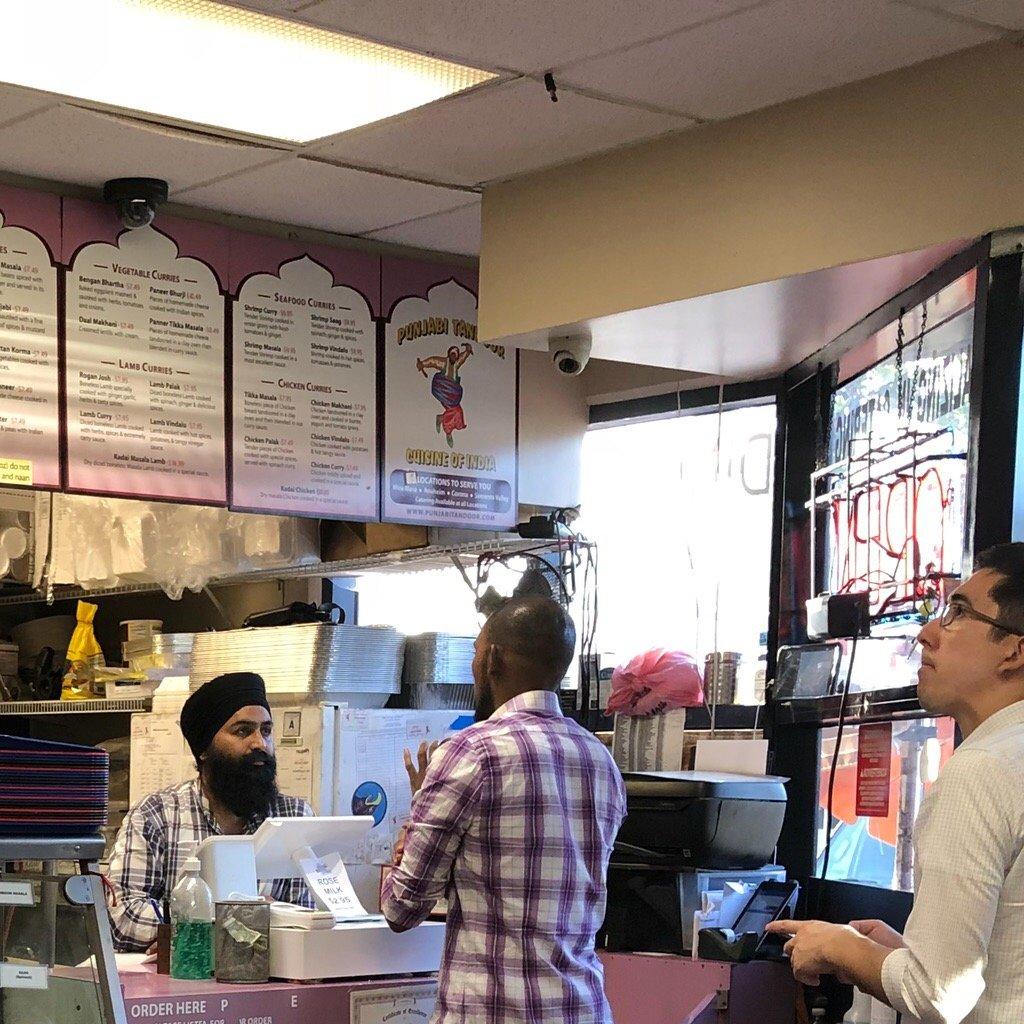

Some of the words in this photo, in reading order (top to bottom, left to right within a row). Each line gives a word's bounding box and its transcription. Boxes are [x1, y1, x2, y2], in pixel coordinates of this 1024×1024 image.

[112, 263, 151, 279] VEGETABLE
[397, 317, 449, 346] PUNJABI
[119, 359, 140, 372] LAMB
[80, 410, 96, 419] Lamb
[96, 412, 112, 421] Curry
[405, 447, 449, 468] CUISINE
[451, 451, 462, 469] OF
[463, 453, 496, 472] INDIA
[10, 462, 18, 470] do
[19, 463, 30, 471] not
[1, 473, 14, 481] and
[417, 475, 450, 488] LOCATIONS
[450, 478, 459, 488] TO
[459, 479, 478, 490] SERVE
[288, 720, 294, 730] A
[317, 876, 339, 886] ROSE
[323, 886, 344, 895] MILK
[131, 1002, 173, 1018] ORDER
[176, 1000, 207, 1015] HERE
[221, 998, 229, 1012] P
[291, 995, 298, 1008] E
